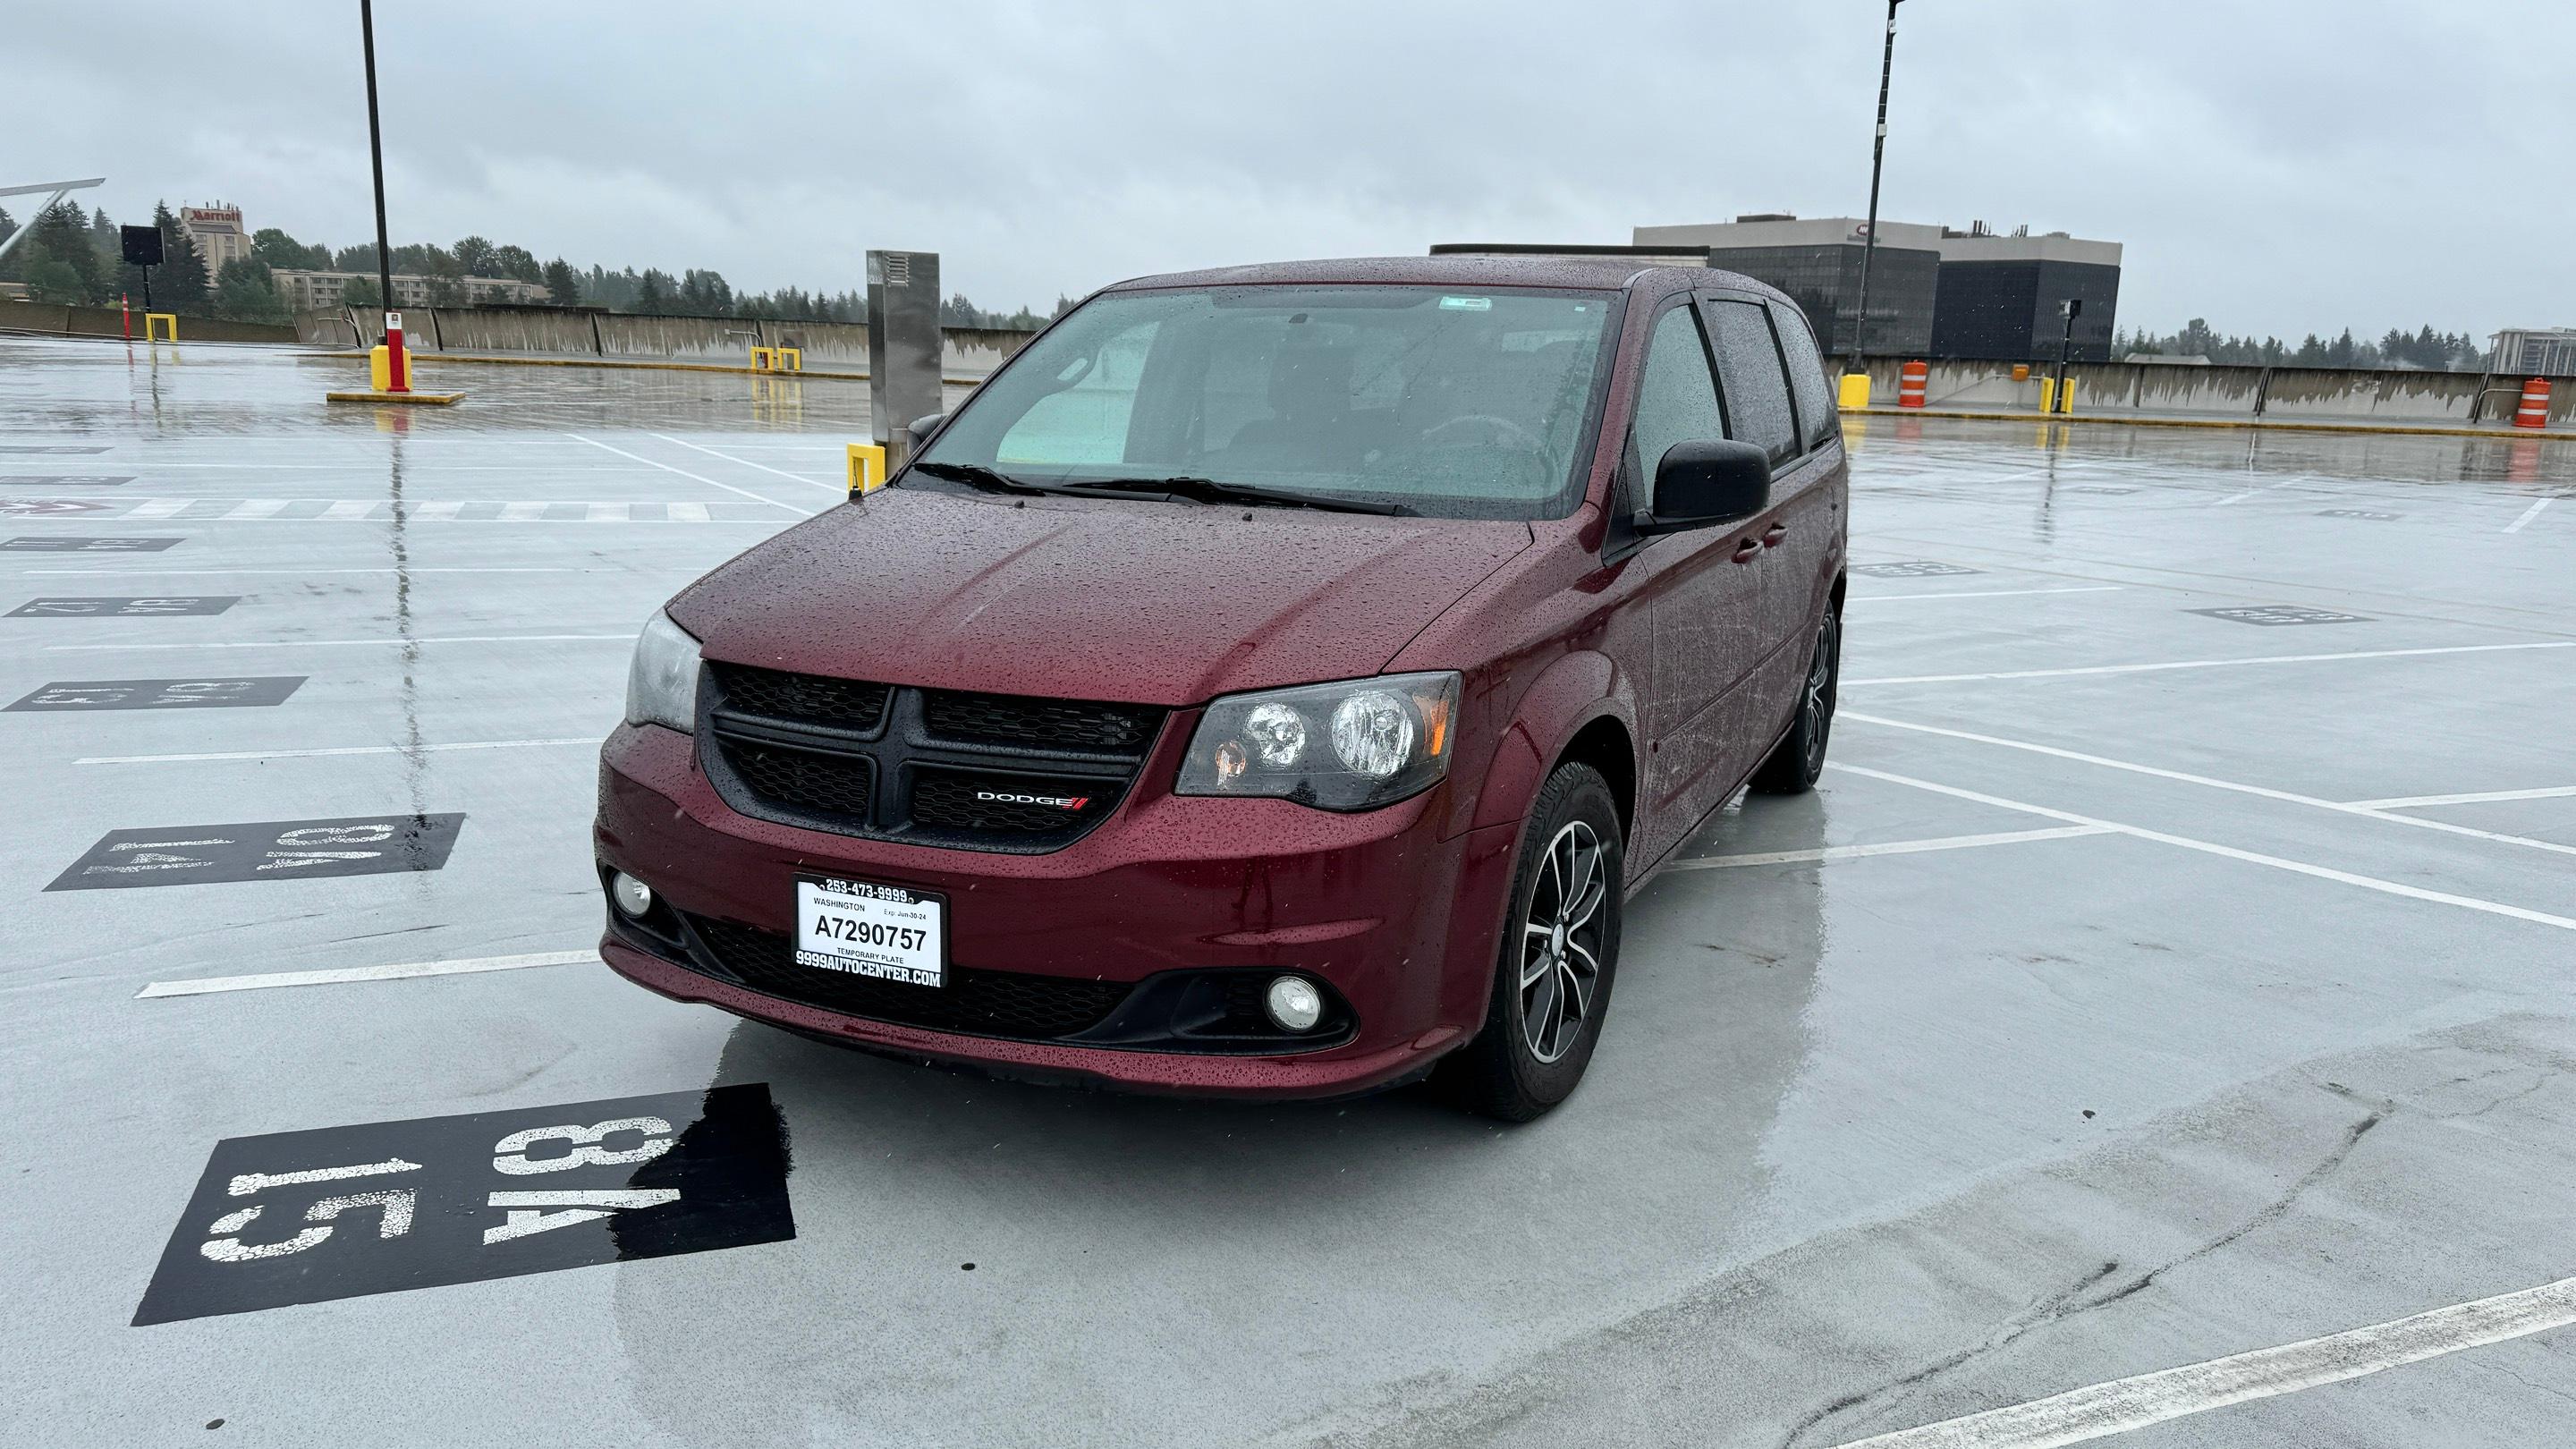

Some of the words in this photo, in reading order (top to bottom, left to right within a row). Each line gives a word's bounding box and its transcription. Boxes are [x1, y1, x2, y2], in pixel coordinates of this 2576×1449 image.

[190, 209, 241, 223] Marriott
[977, 792, 1073, 807] DODGE
[82, 837, 236, 875] 14
[256, 823, 395, 871] 8A
[813, 897, 865, 912] WASHINGTON
[826, 878, 908, 902] 253-473-9999
[815, 914, 927, 952] A7290757
[795, 950, 941, 988] 9999AUTOCENTER.COM
[837, 947, 879, 961] TEMPORARY
[881, 955, 904, 964] PLATE
[483, 1115, 682, 1245] 8A
[199, 1157, 423, 1264] 15
